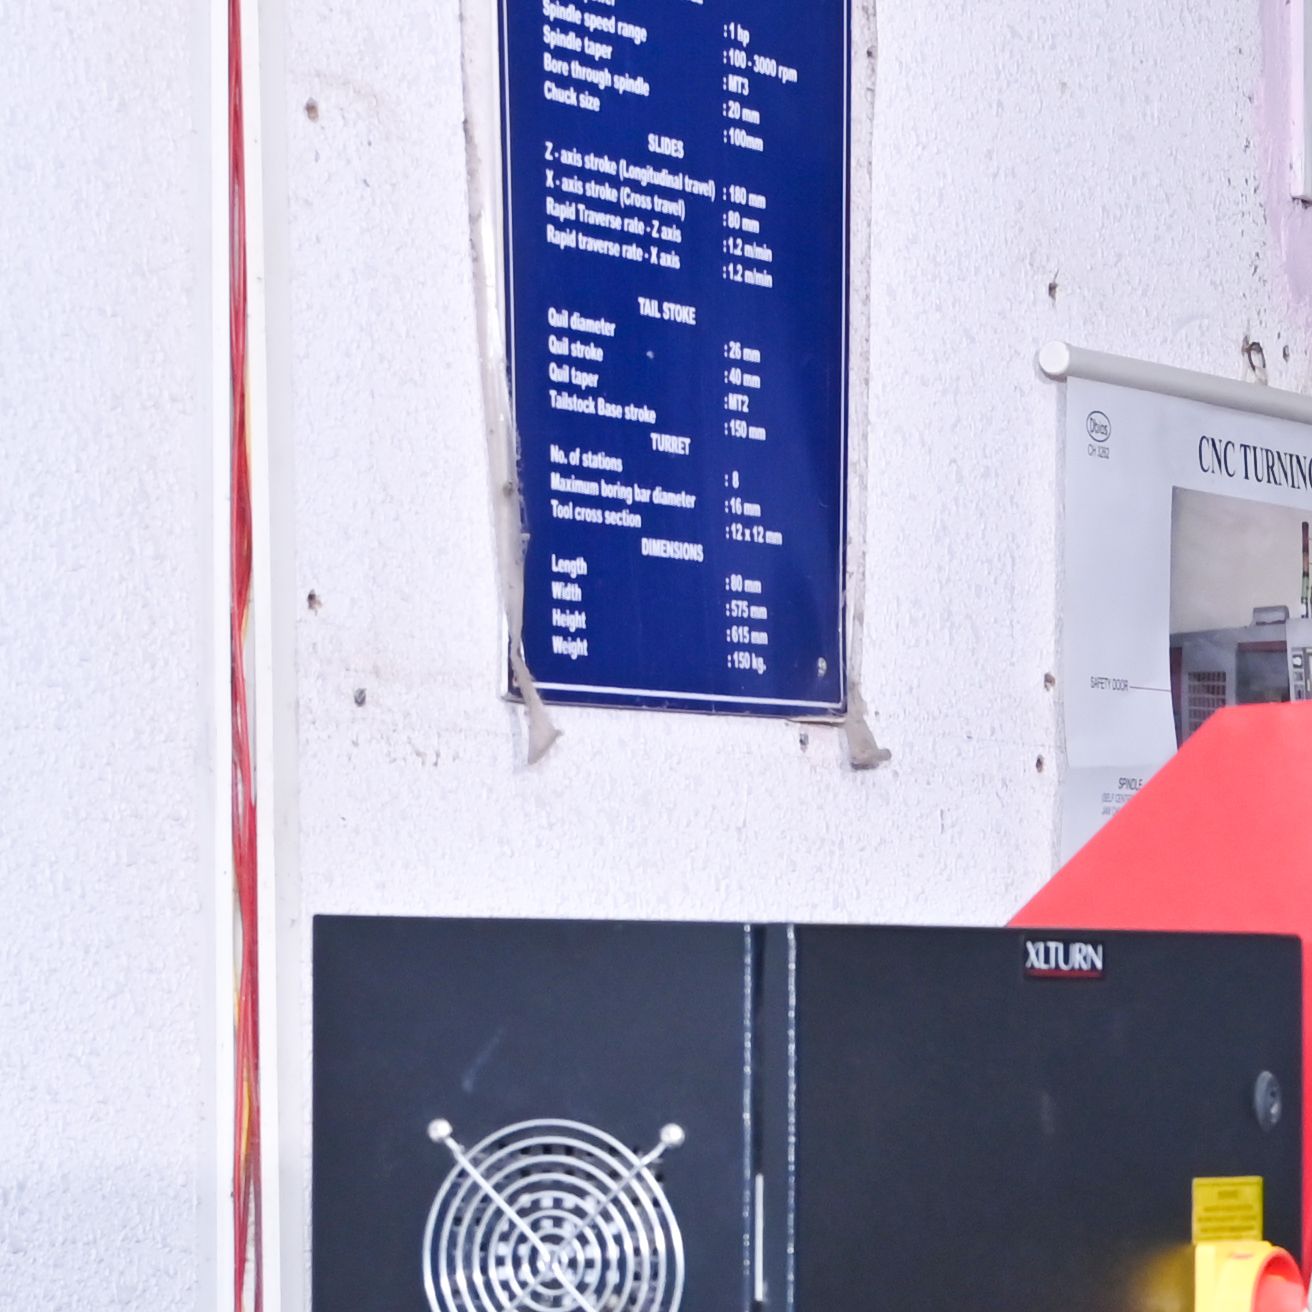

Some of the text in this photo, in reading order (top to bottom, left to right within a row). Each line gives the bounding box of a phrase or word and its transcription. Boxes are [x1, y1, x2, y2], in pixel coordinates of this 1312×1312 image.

[542, 0, 647, 45] Spindle speed range
[543, 24, 613, 61] Spindle taper
[543, 52, 650, 96] Bore through spindle
[544, 80, 600, 111] Chuck size
[648, 133, 684, 159] SLIDES
[545, 141, 553, 160] Z
[560, 148, 582, 167] axis
[584, 153, 617, 175] stroke
[684, 175, 715, 202] travel)
[546, 169, 554, 188] X
[561, 176, 583, 195] axis
[585, 180, 618, 202] stroke
[620, 186, 652, 210] (Cross
[653, 195, 685, 221] travel)
[546, 196, 576, 222] Rapid
[577, 203, 622, 230] Traverse
[624, 217, 645, 235] rate
[651, 220, 659, 238] Z
[661, 225, 682, 243] axis
[547, 224, 576, 249] Rapid
[578, 232, 620, 257] traverse
[622, 243, 643, 261] rate
[650, 246, 658, 264] X
[659, 251, 680, 269] axis
[570, 312, 616, 336] diameter
[638, 297, 696, 325] TAIL STOKE
[570, 341, 603, 362] stroke
[571, 367, 599, 390] taper
[549, 389, 656, 424] Tailstock Base stroke
[550, 444, 623, 472] No. of stations
[650, 432, 691, 455] TURRET
[1198, 434, 1237, 477] CNC
[550, 472, 696, 508] Maximum boring bar diameter
[550, 499, 641, 528] Tool cross section
[641, 538, 704, 562] DIMENSIONS
[551, 554, 587, 579] Length
[552, 608, 586, 632] Height
[552, 635, 588, 660] Weight
[1090, 676, 1129, 692] SAFETY DOOR
[1025, 941, 1103, 971] XLTURN
